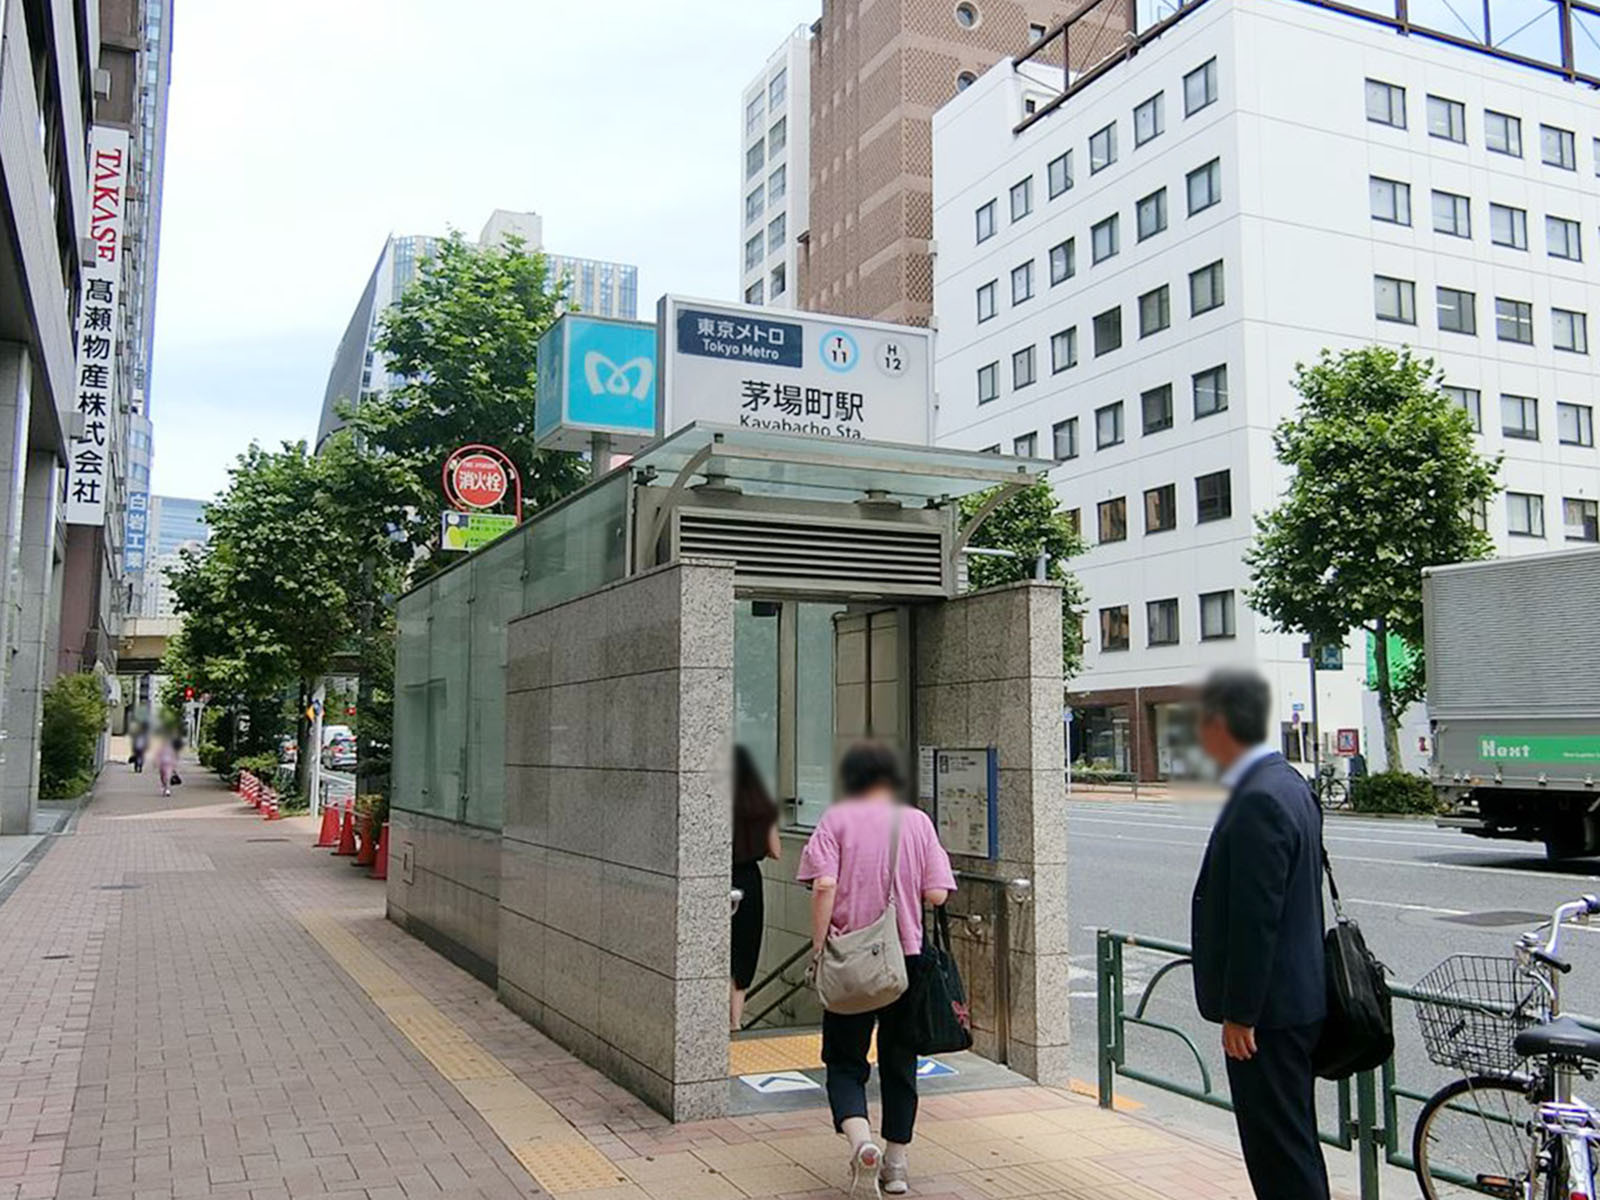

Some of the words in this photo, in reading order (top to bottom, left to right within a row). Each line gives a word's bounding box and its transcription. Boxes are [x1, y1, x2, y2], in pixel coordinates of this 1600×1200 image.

[91, 148, 121, 262] TAKASE
[697, 318, 784, 345] 東京メトロ
[702, 339, 740, 357] Tokyo
[741, 344, 780, 360] Metro
[835, 337, 844, 349] T
[887, 344, 898, 356] H
[831, 350, 848, 364] 11
[884, 356, 902, 371] 12
[741, 379, 864, 423] 茅場町駅
[459, 470, 502, 492] 消火栓
